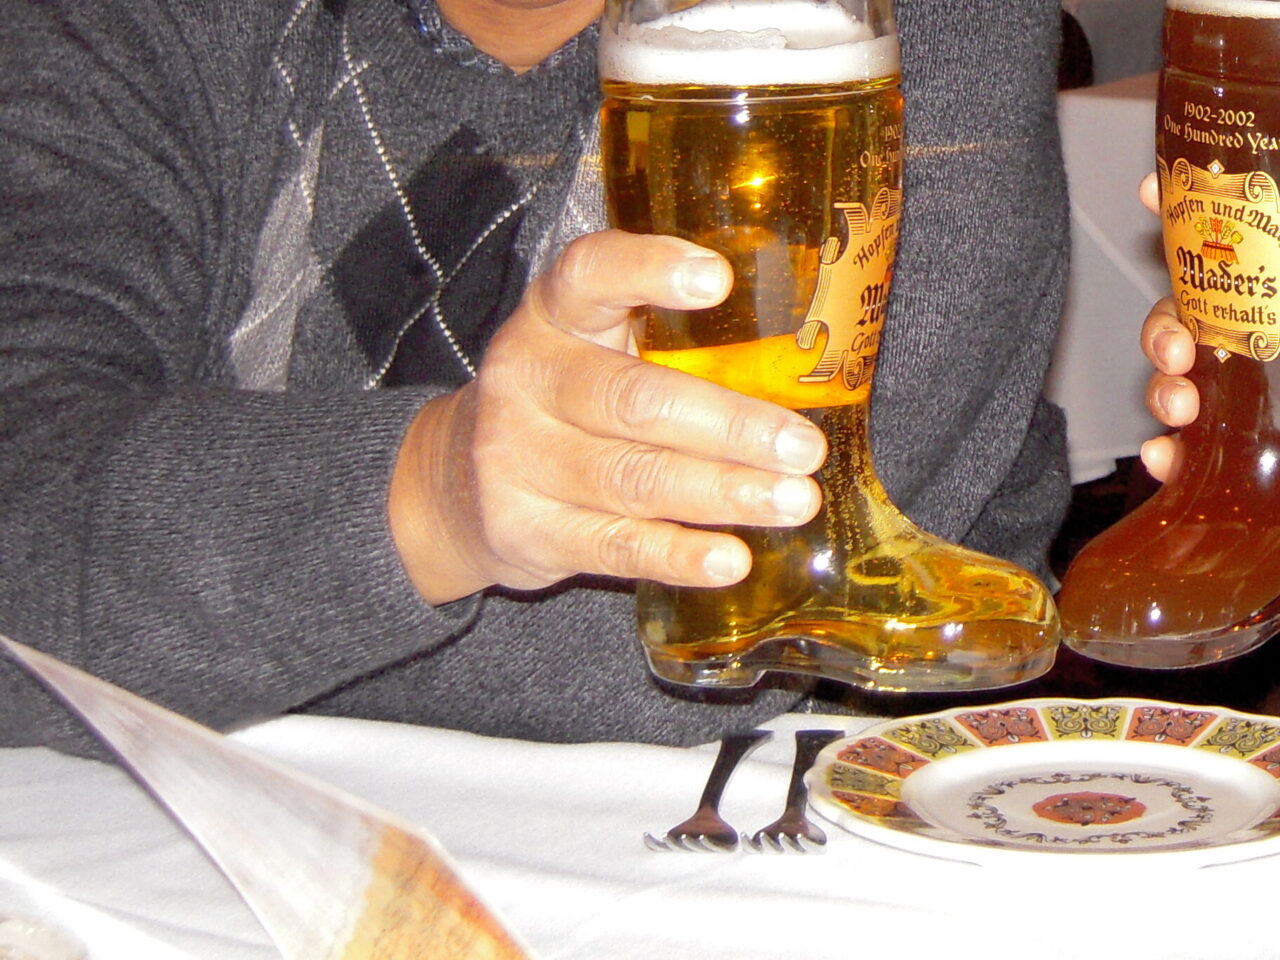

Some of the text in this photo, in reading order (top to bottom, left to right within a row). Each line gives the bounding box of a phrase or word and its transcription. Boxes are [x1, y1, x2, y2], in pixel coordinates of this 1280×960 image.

[1184, 101, 1255, 127] 1902-2002
[1164, 114, 1181, 136] One
[1184, 123, 1244, 148] Hundred
[1167, 195, 1204, 227] Hopfen
[1211, 200, 1246, 222] und
[1176, 246, 1278, 298] Mader's
[1180, 290, 1208, 315] Gott
